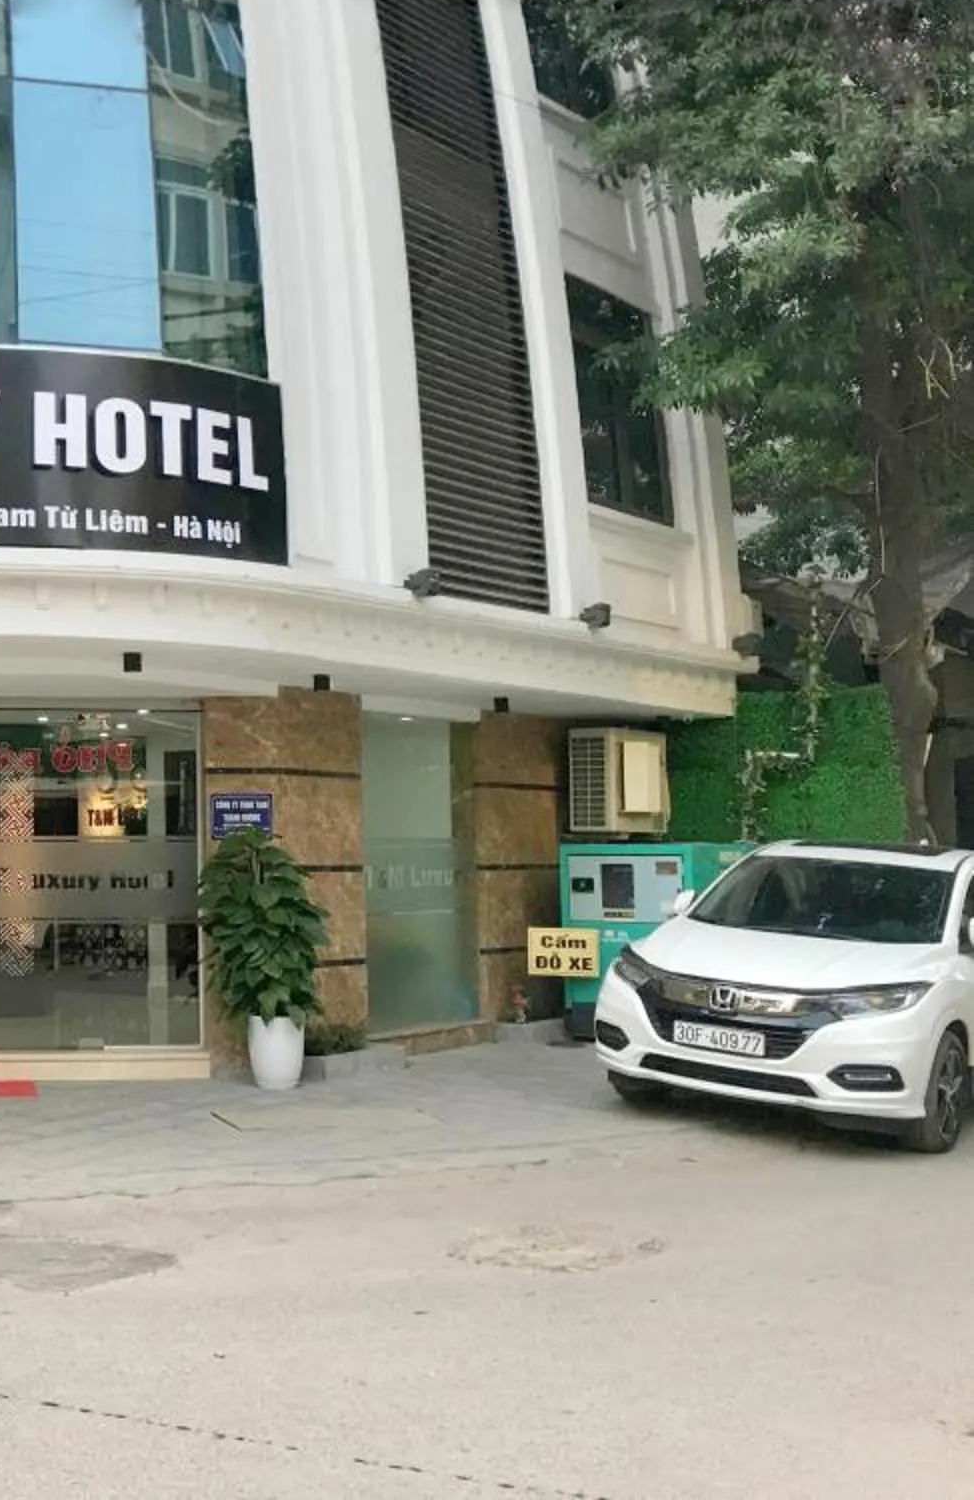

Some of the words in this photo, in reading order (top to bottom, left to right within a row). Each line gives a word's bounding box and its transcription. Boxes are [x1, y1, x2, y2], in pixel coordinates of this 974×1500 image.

[33, 391, 269, 492] HOTEL
[85, 508, 148, 534] Liêm
[174, 515, 202, 539] Hà
[208, 519, 241, 548] Nội
[569, 957, 593, 971] XE
